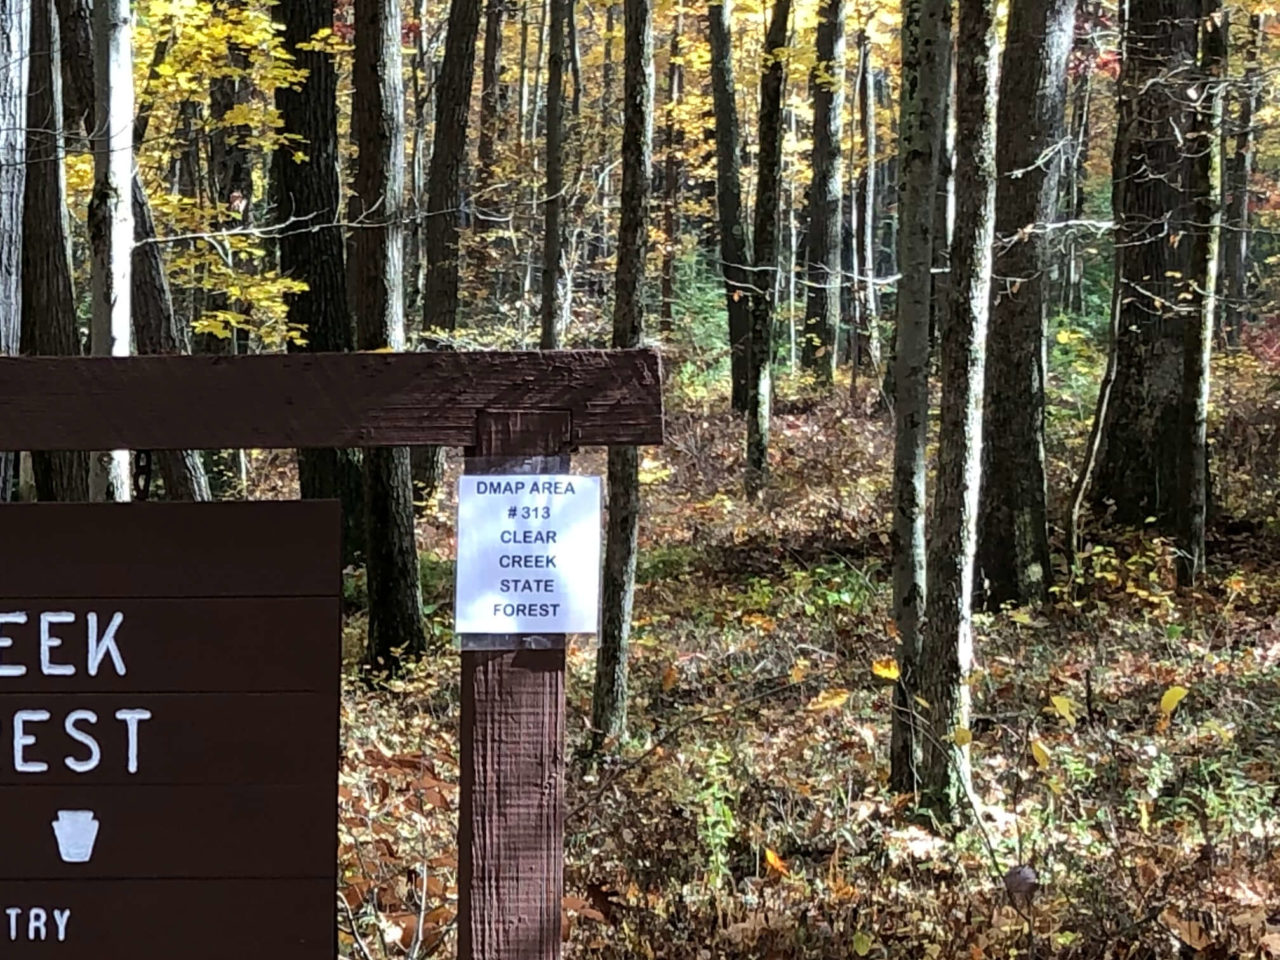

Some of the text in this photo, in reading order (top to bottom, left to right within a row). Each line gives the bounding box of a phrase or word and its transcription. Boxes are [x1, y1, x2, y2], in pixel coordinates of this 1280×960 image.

[477, 481, 575, 495] DMAP AREA
[521, 506, 551, 519] 313
[500, 531, 556, 544] CLEAR
[499, 555, 556, 568] CREEK
[500, 579, 554, 592] STATE
[493, 603, 560, 617] FOREST
